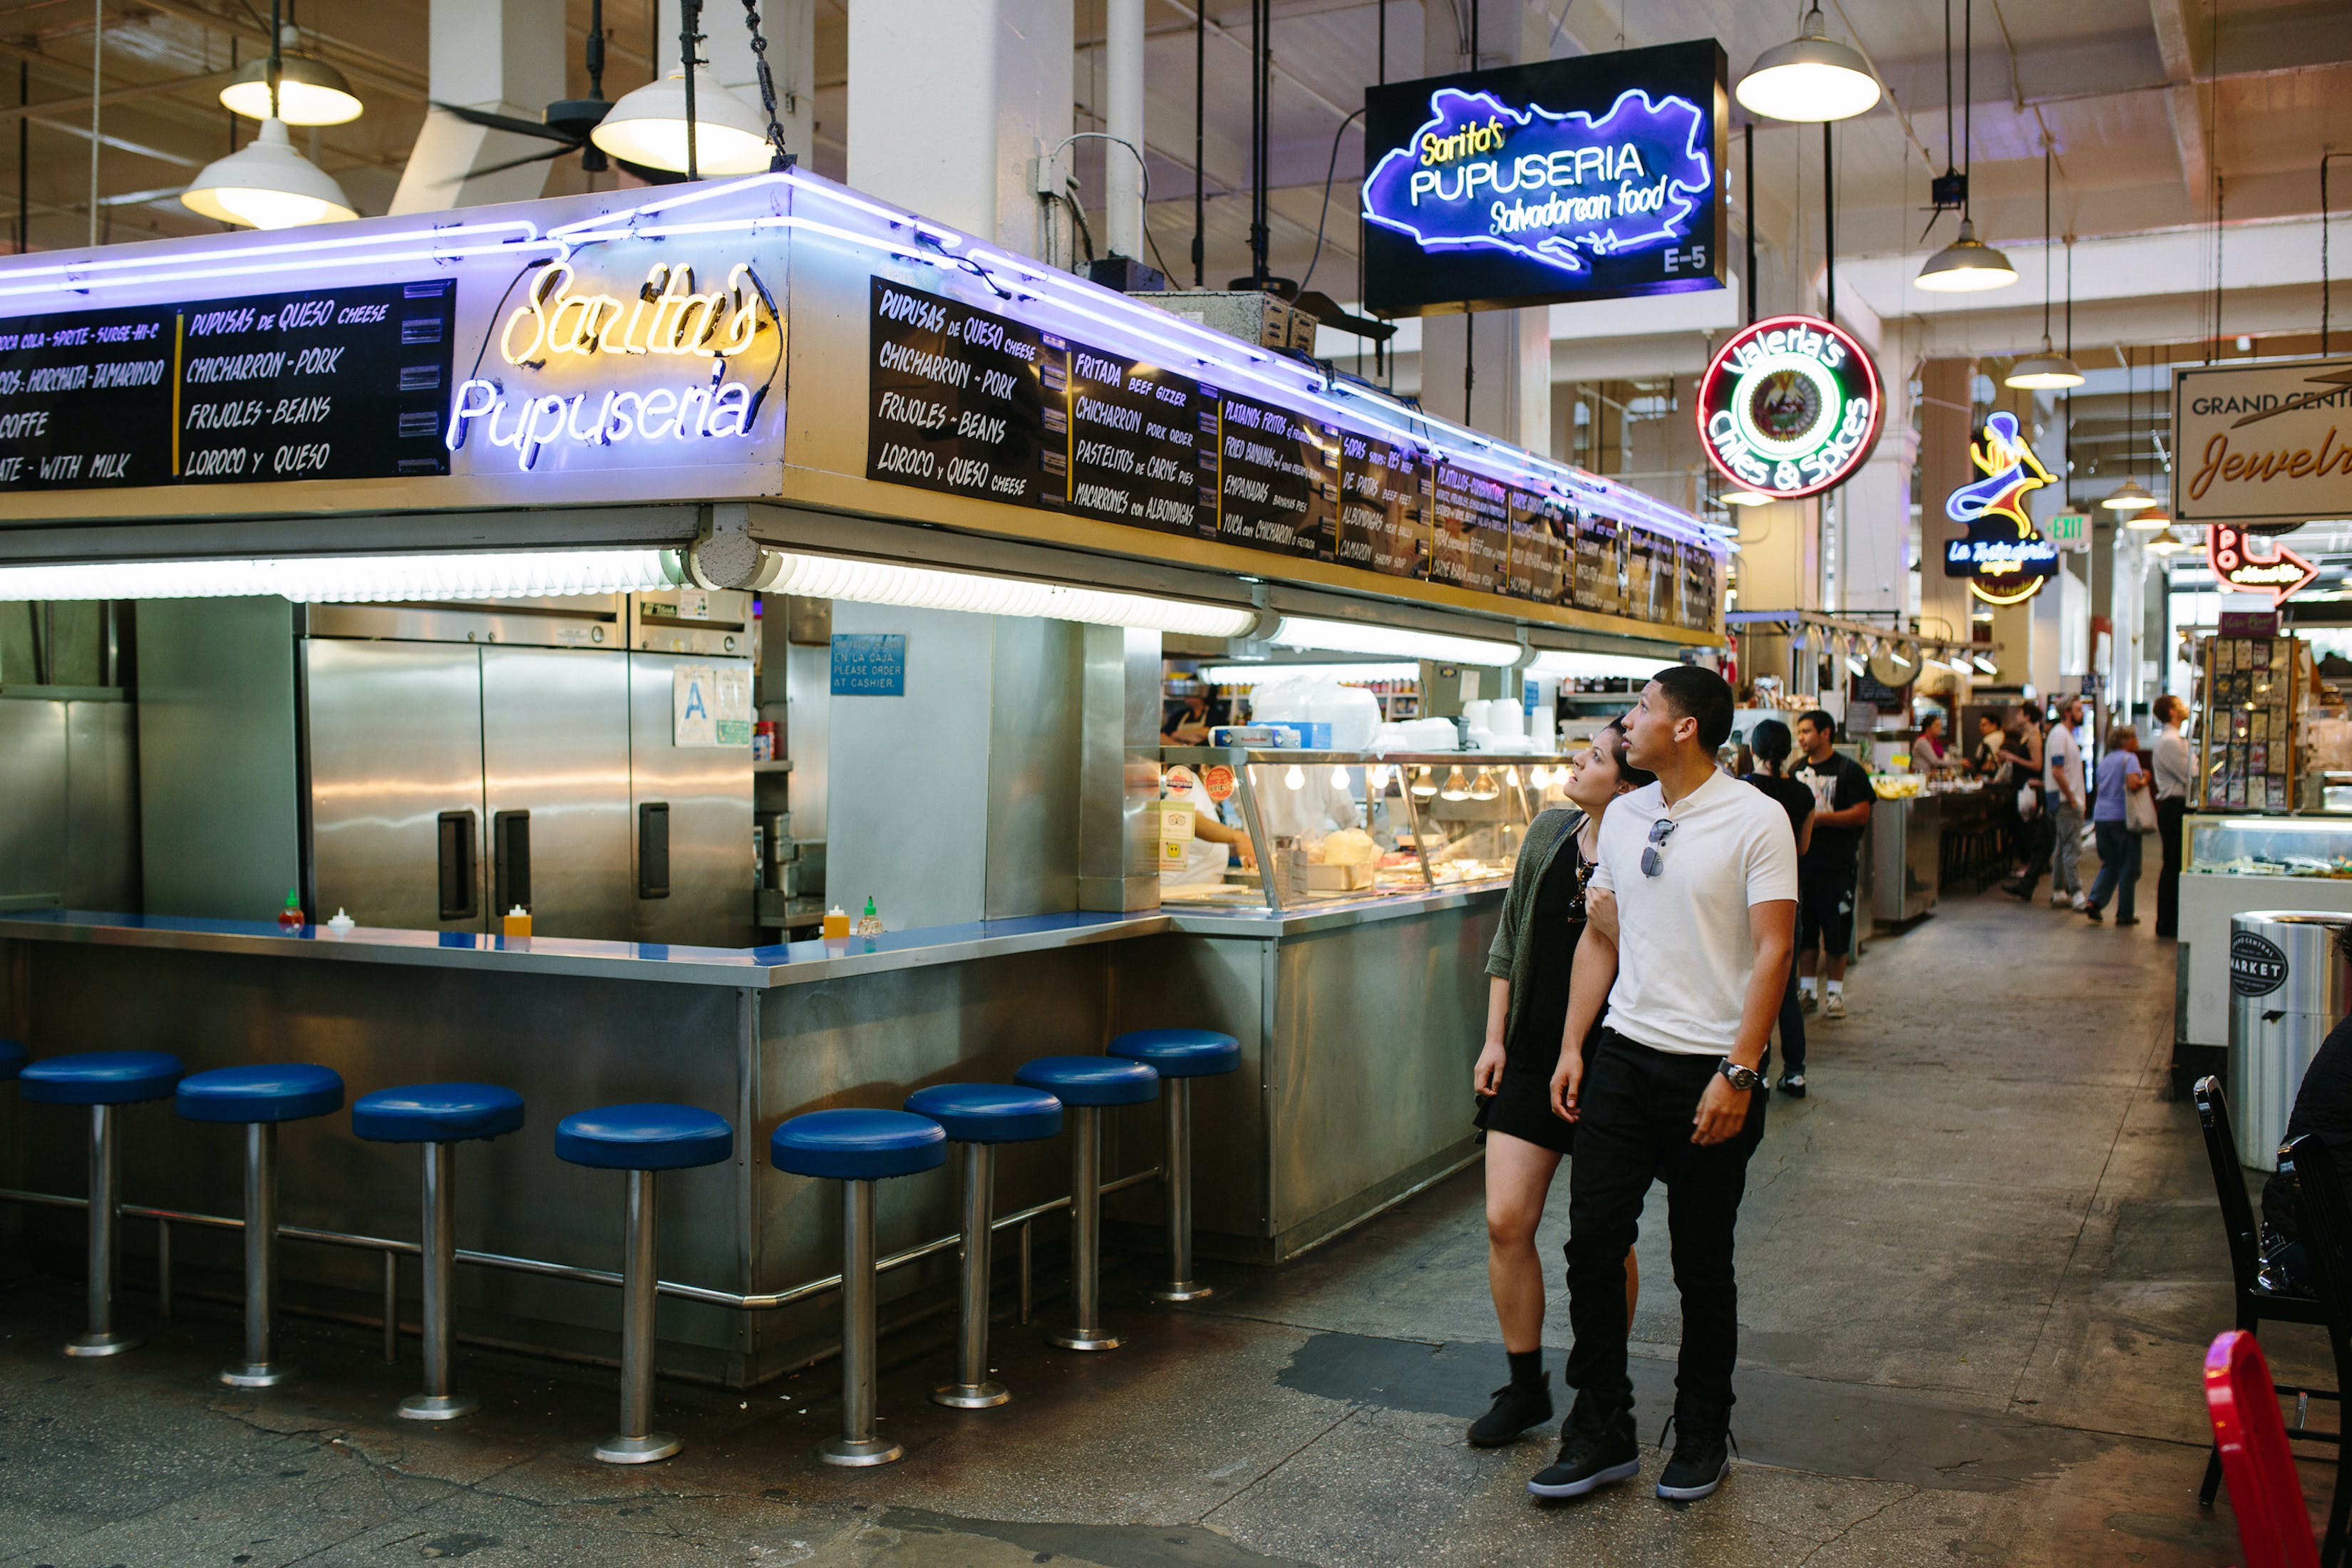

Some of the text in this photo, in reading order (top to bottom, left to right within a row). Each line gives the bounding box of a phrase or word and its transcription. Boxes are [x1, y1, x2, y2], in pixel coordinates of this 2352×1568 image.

[1420, 116, 1504, 166] Sarita's
[1410, 143, 1644, 207] PUPUSERIA
[1489, 175, 1668, 235] Salvadorean food
[1664, 247, 1706, 272] E-5
[190, 299, 389, 336] PUPUSAS DE QUESO CHEESE
[879, 289, 1036, 362] PUPUSAS DE QUESO CHEESE
[1721, 323, 1845, 374] Valeria's
[1074, 353, 1187, 407] FRITADA BEEF GIZZER
[1224, 401, 1262, 429] PLATANOS
[1261, 412, 1287, 435] FRITOS
[2192, 390, 2352, 416] GRAND CENT
[0, 411, 50, 439] COFFE
[1076, 396, 1193, 447] CHICHARRON PORK ORDER
[185, 448, 246, 477] LOROCO
[274, 443, 331, 472] QUESO
[1224, 435, 1245, 459] FRIED
[1244, 441, 1276, 468] BANANAS
[1343, 437, 1366, 460] SOPAS
[1708, 397, 1869, 490] Chiles & Spices
[40, 455, 83, 480] WITH
[88, 453, 131, 478] MILK
[877, 442, 934, 478] LOROCO
[947, 457, 989, 488] QUESO
[991, 474, 1027, 496] CHEESE
[1076, 439, 1194, 486] PASTELITOS DE CARNE PIES
[2189, 425, 2352, 500] Jewelr
[1224, 474, 1308, 512] EMPANADAS BANANAS PIES
[1343, 472, 1356, 490] DE
[1356, 475, 1379, 497] PATAS
[1382, 489, 1398, 501] BEEF
[1074, 483, 1130, 515] MACARRONES
[1145, 497, 1195, 526] ALBONDIGAS
[1342, 505, 1383, 532] ALBONDIGAS
[1223, 513, 1243, 535] YUCA
[2053, 517, 2083, 539] EXIT
[1340, 540, 1373, 562] CAMARON
[834, 665, 901, 676] PLEASE ORDER
[835, 653, 847, 662] EN
[852, 654, 865, 662] LA
[835, 679, 846, 687] AT
[685, 682, 706, 719] A
[2245, 937, 2274, 957] CENTRAL
